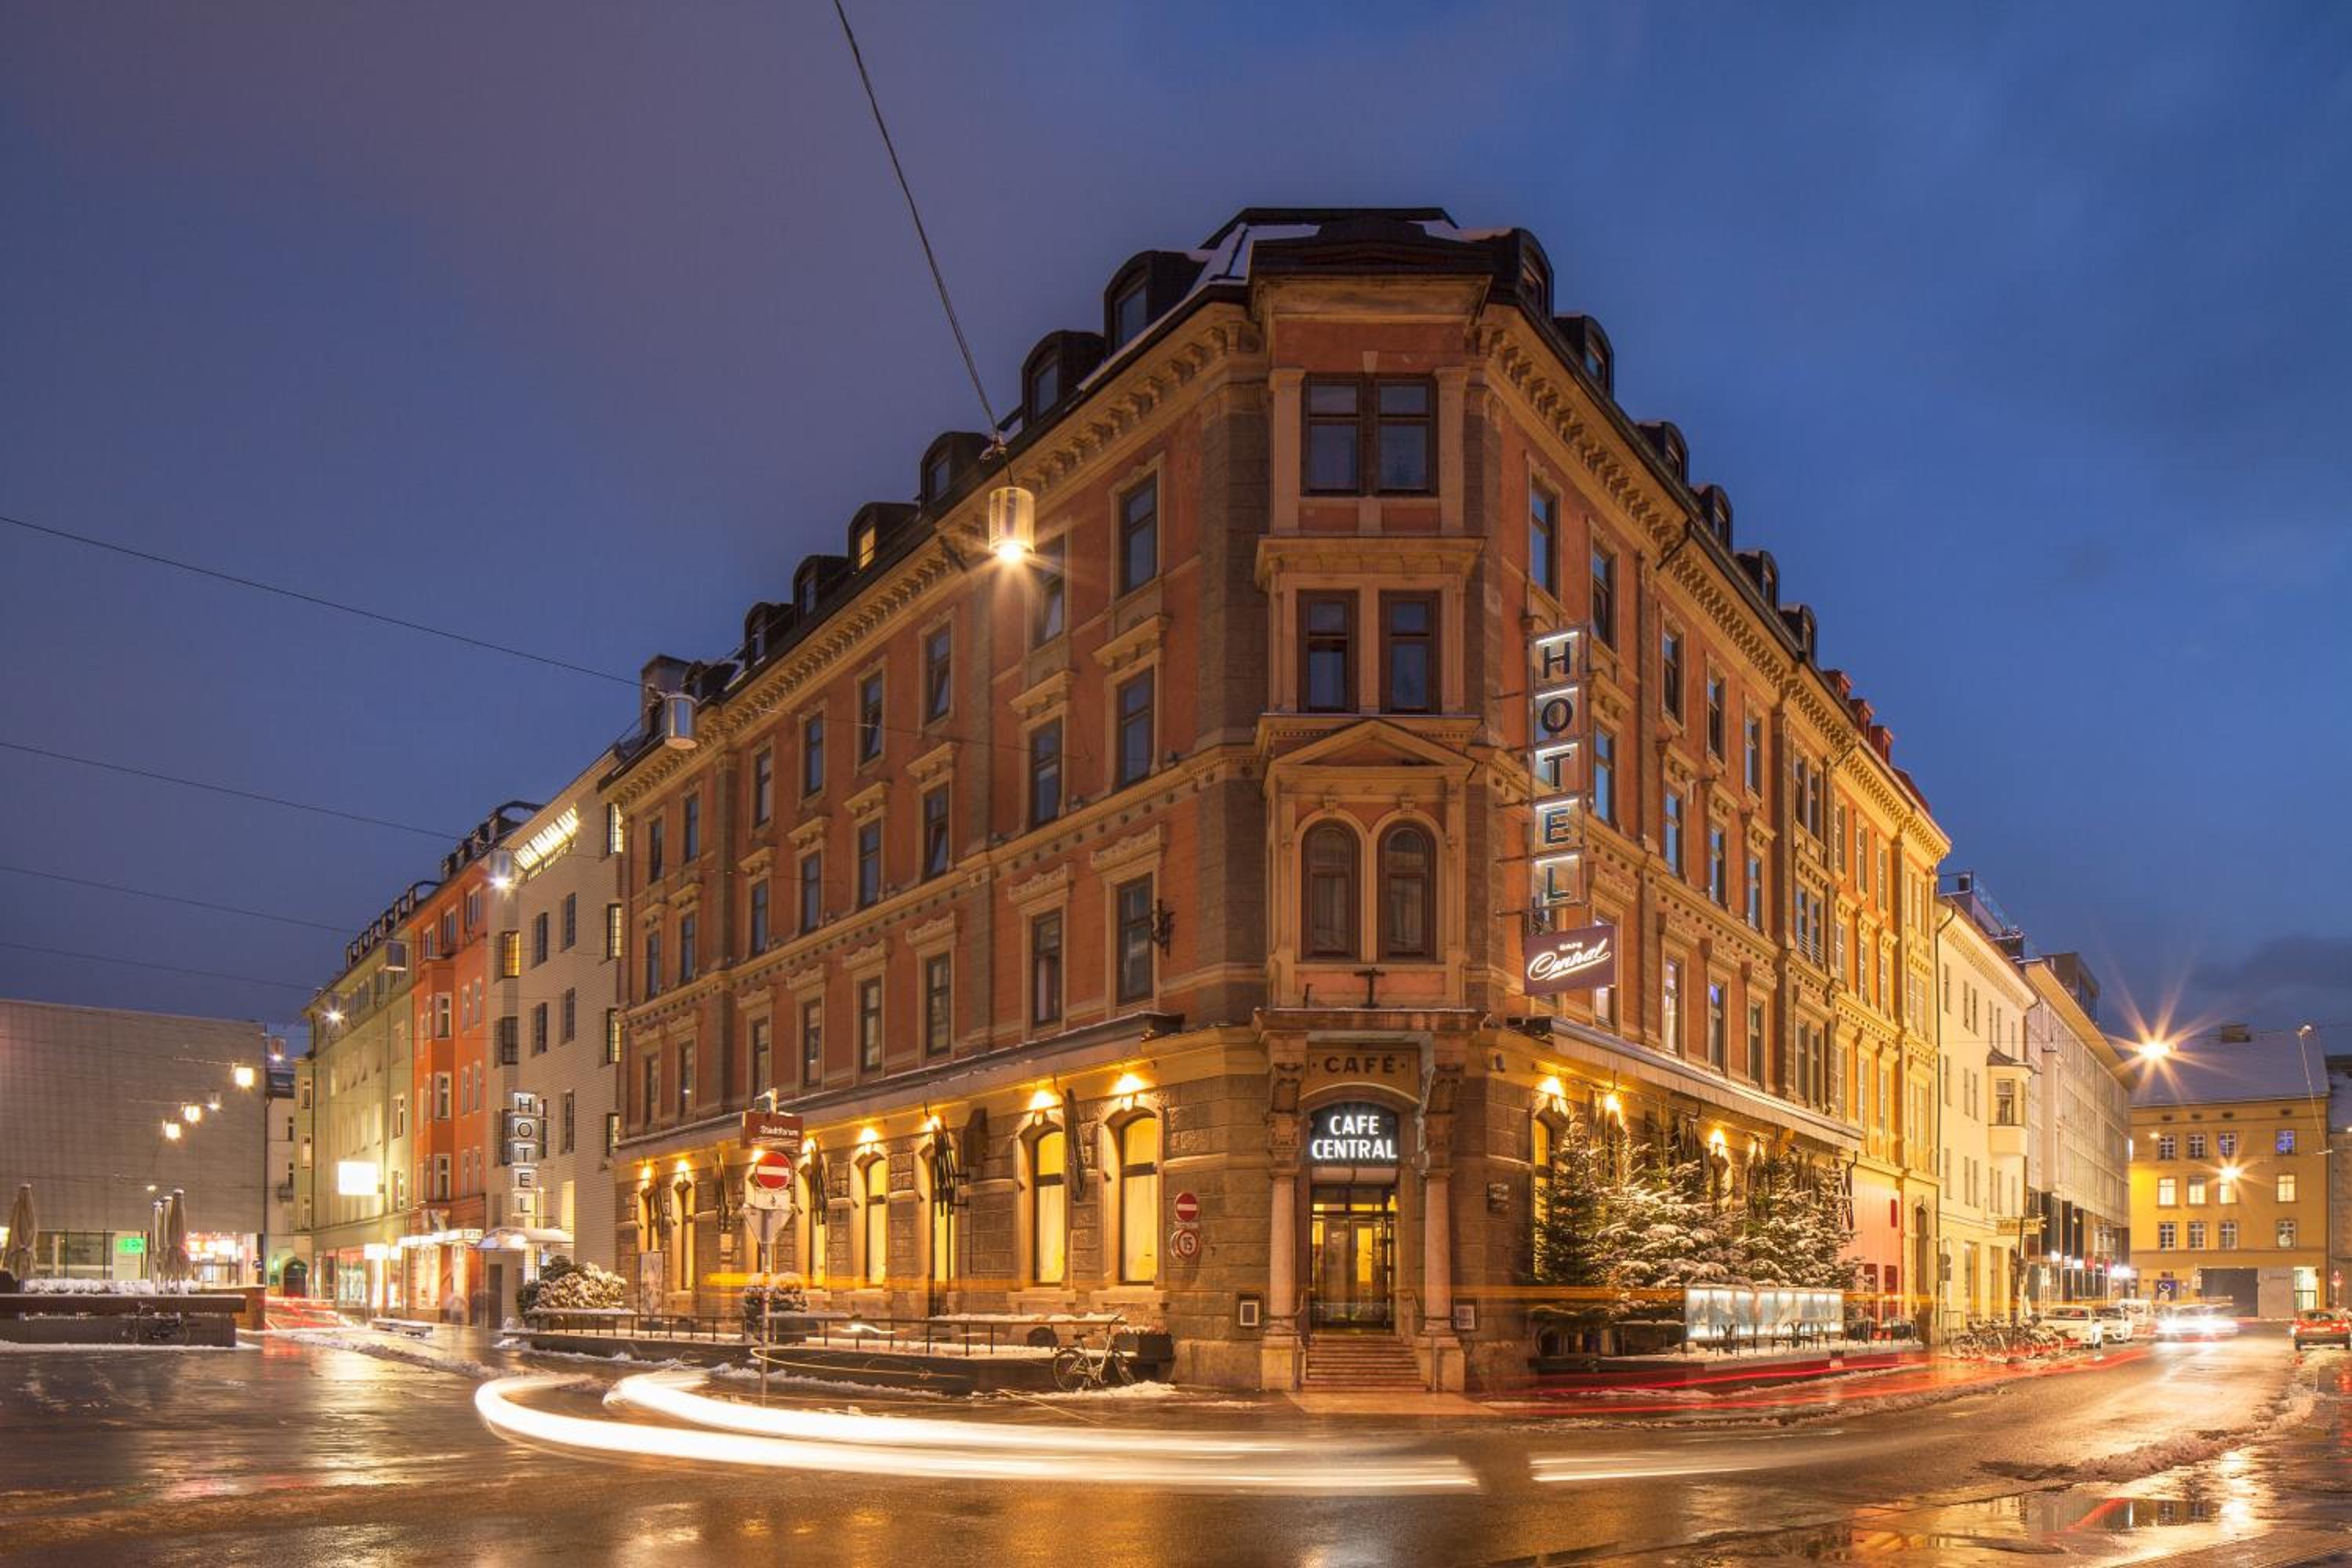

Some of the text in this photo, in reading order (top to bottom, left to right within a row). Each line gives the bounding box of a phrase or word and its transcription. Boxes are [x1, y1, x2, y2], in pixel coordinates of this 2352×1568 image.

[1541, 641, 1573, 900] HOTEL
[1527, 938, 1611, 981] Central
[1324, 1054, 1396, 1074] CAFÉ
[1329, 1115, 1380, 1135] CAFE
[517, 1098, 532, 1213] HOTEL
[1312, 1139, 1398, 1159] CENTRAL
